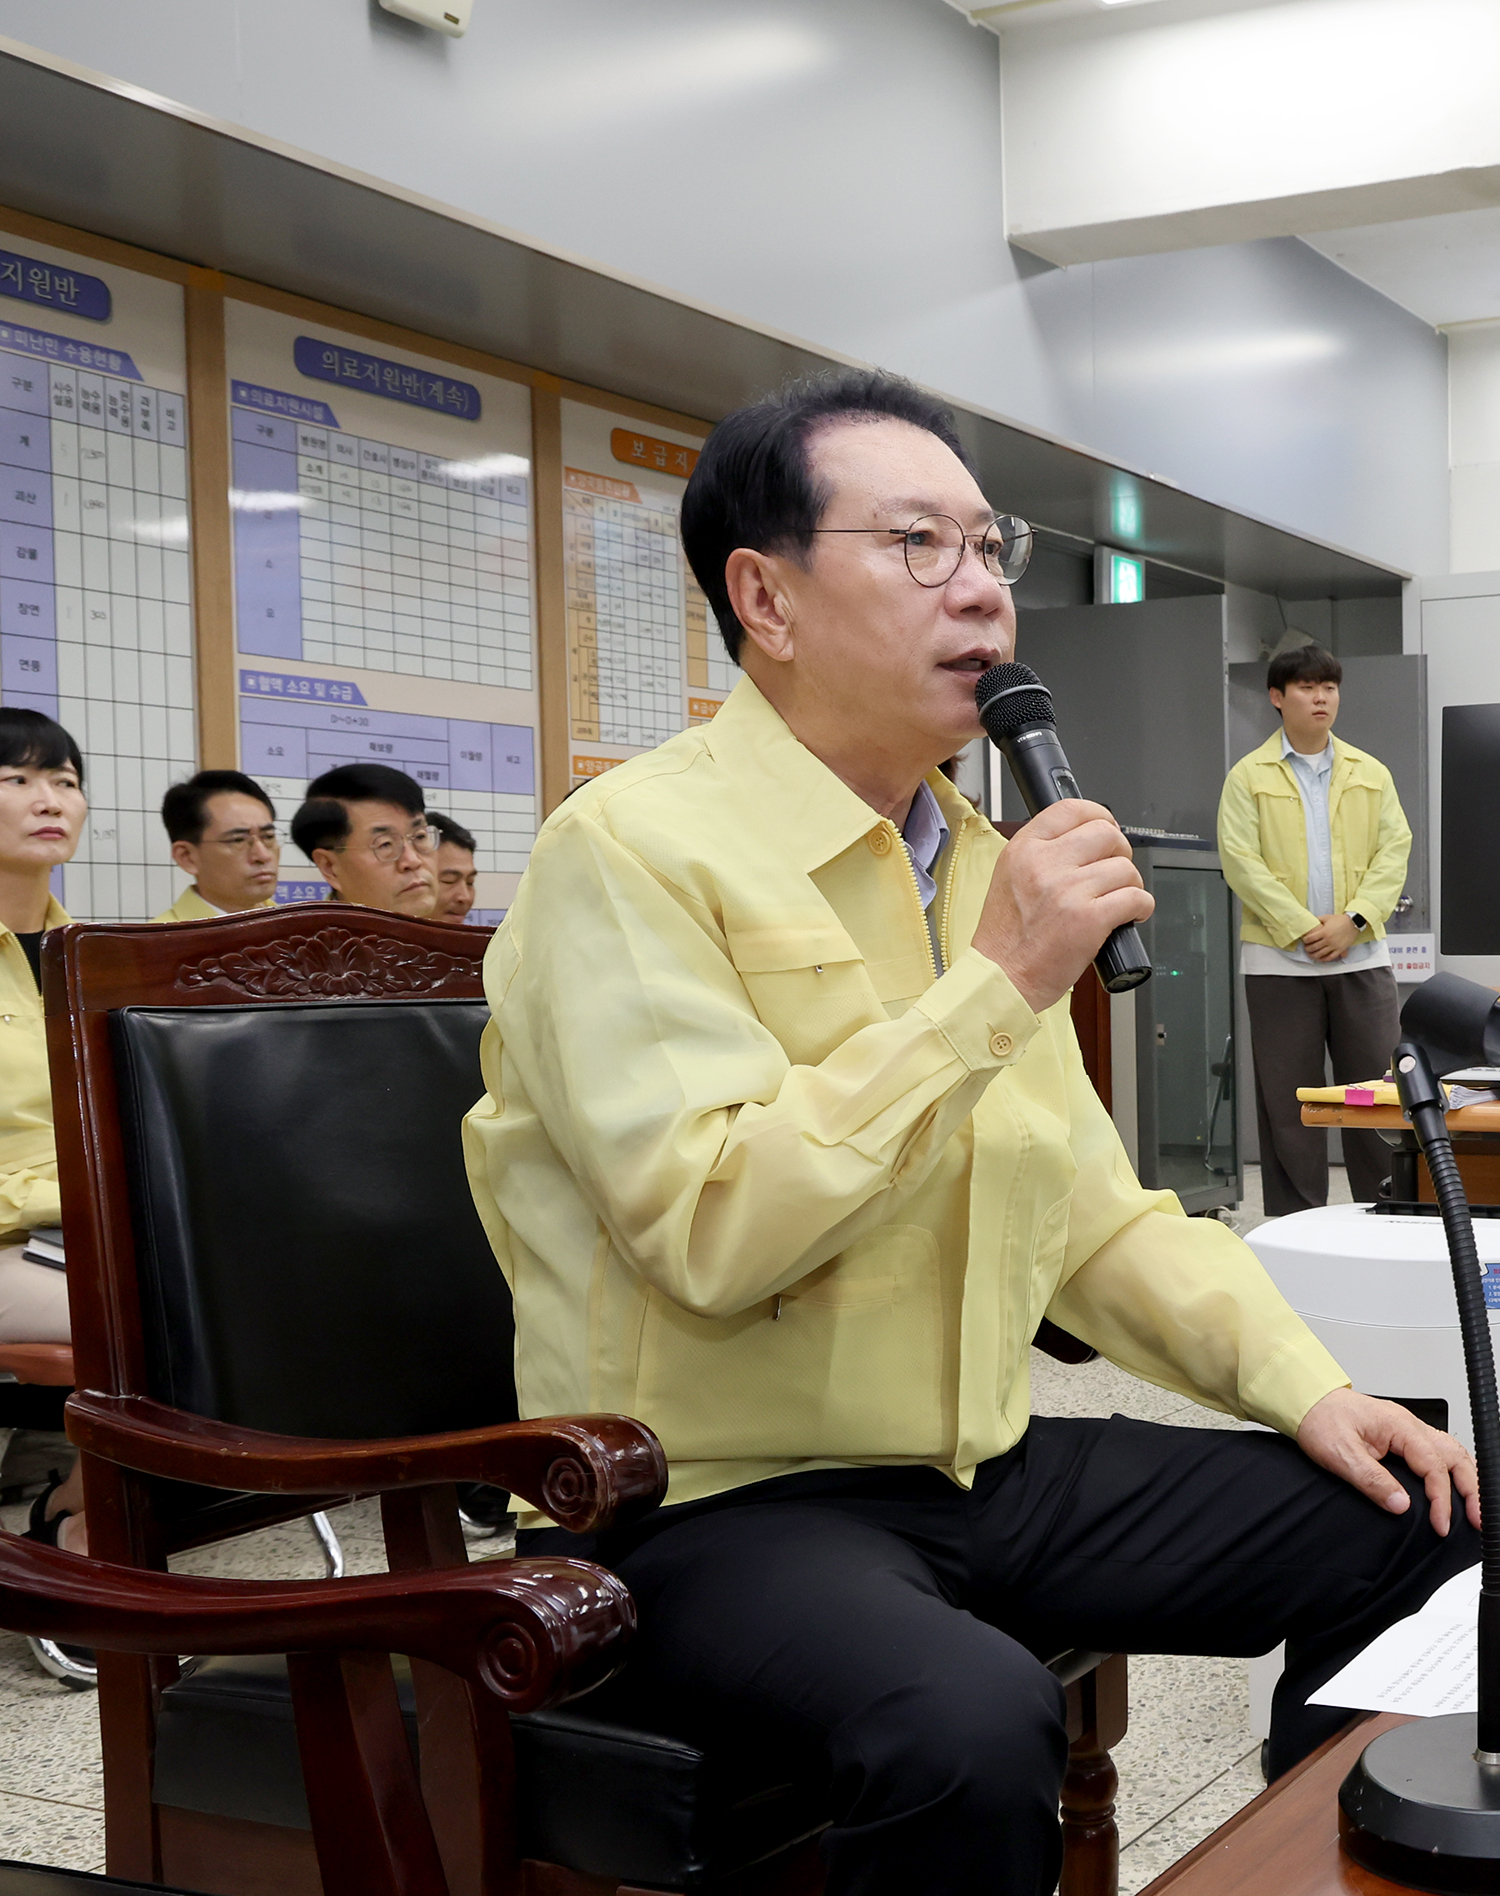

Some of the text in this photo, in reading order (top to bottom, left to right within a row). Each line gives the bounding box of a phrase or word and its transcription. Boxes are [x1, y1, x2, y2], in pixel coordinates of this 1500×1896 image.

[1, 261, 80, 307] 지원반
[322, 350, 470, 413] 의료지원반(계속)
[633, 440, 688, 473] 보급지
[287, 680, 311, 695] 소요
[329, 684, 353, 701] 수급
